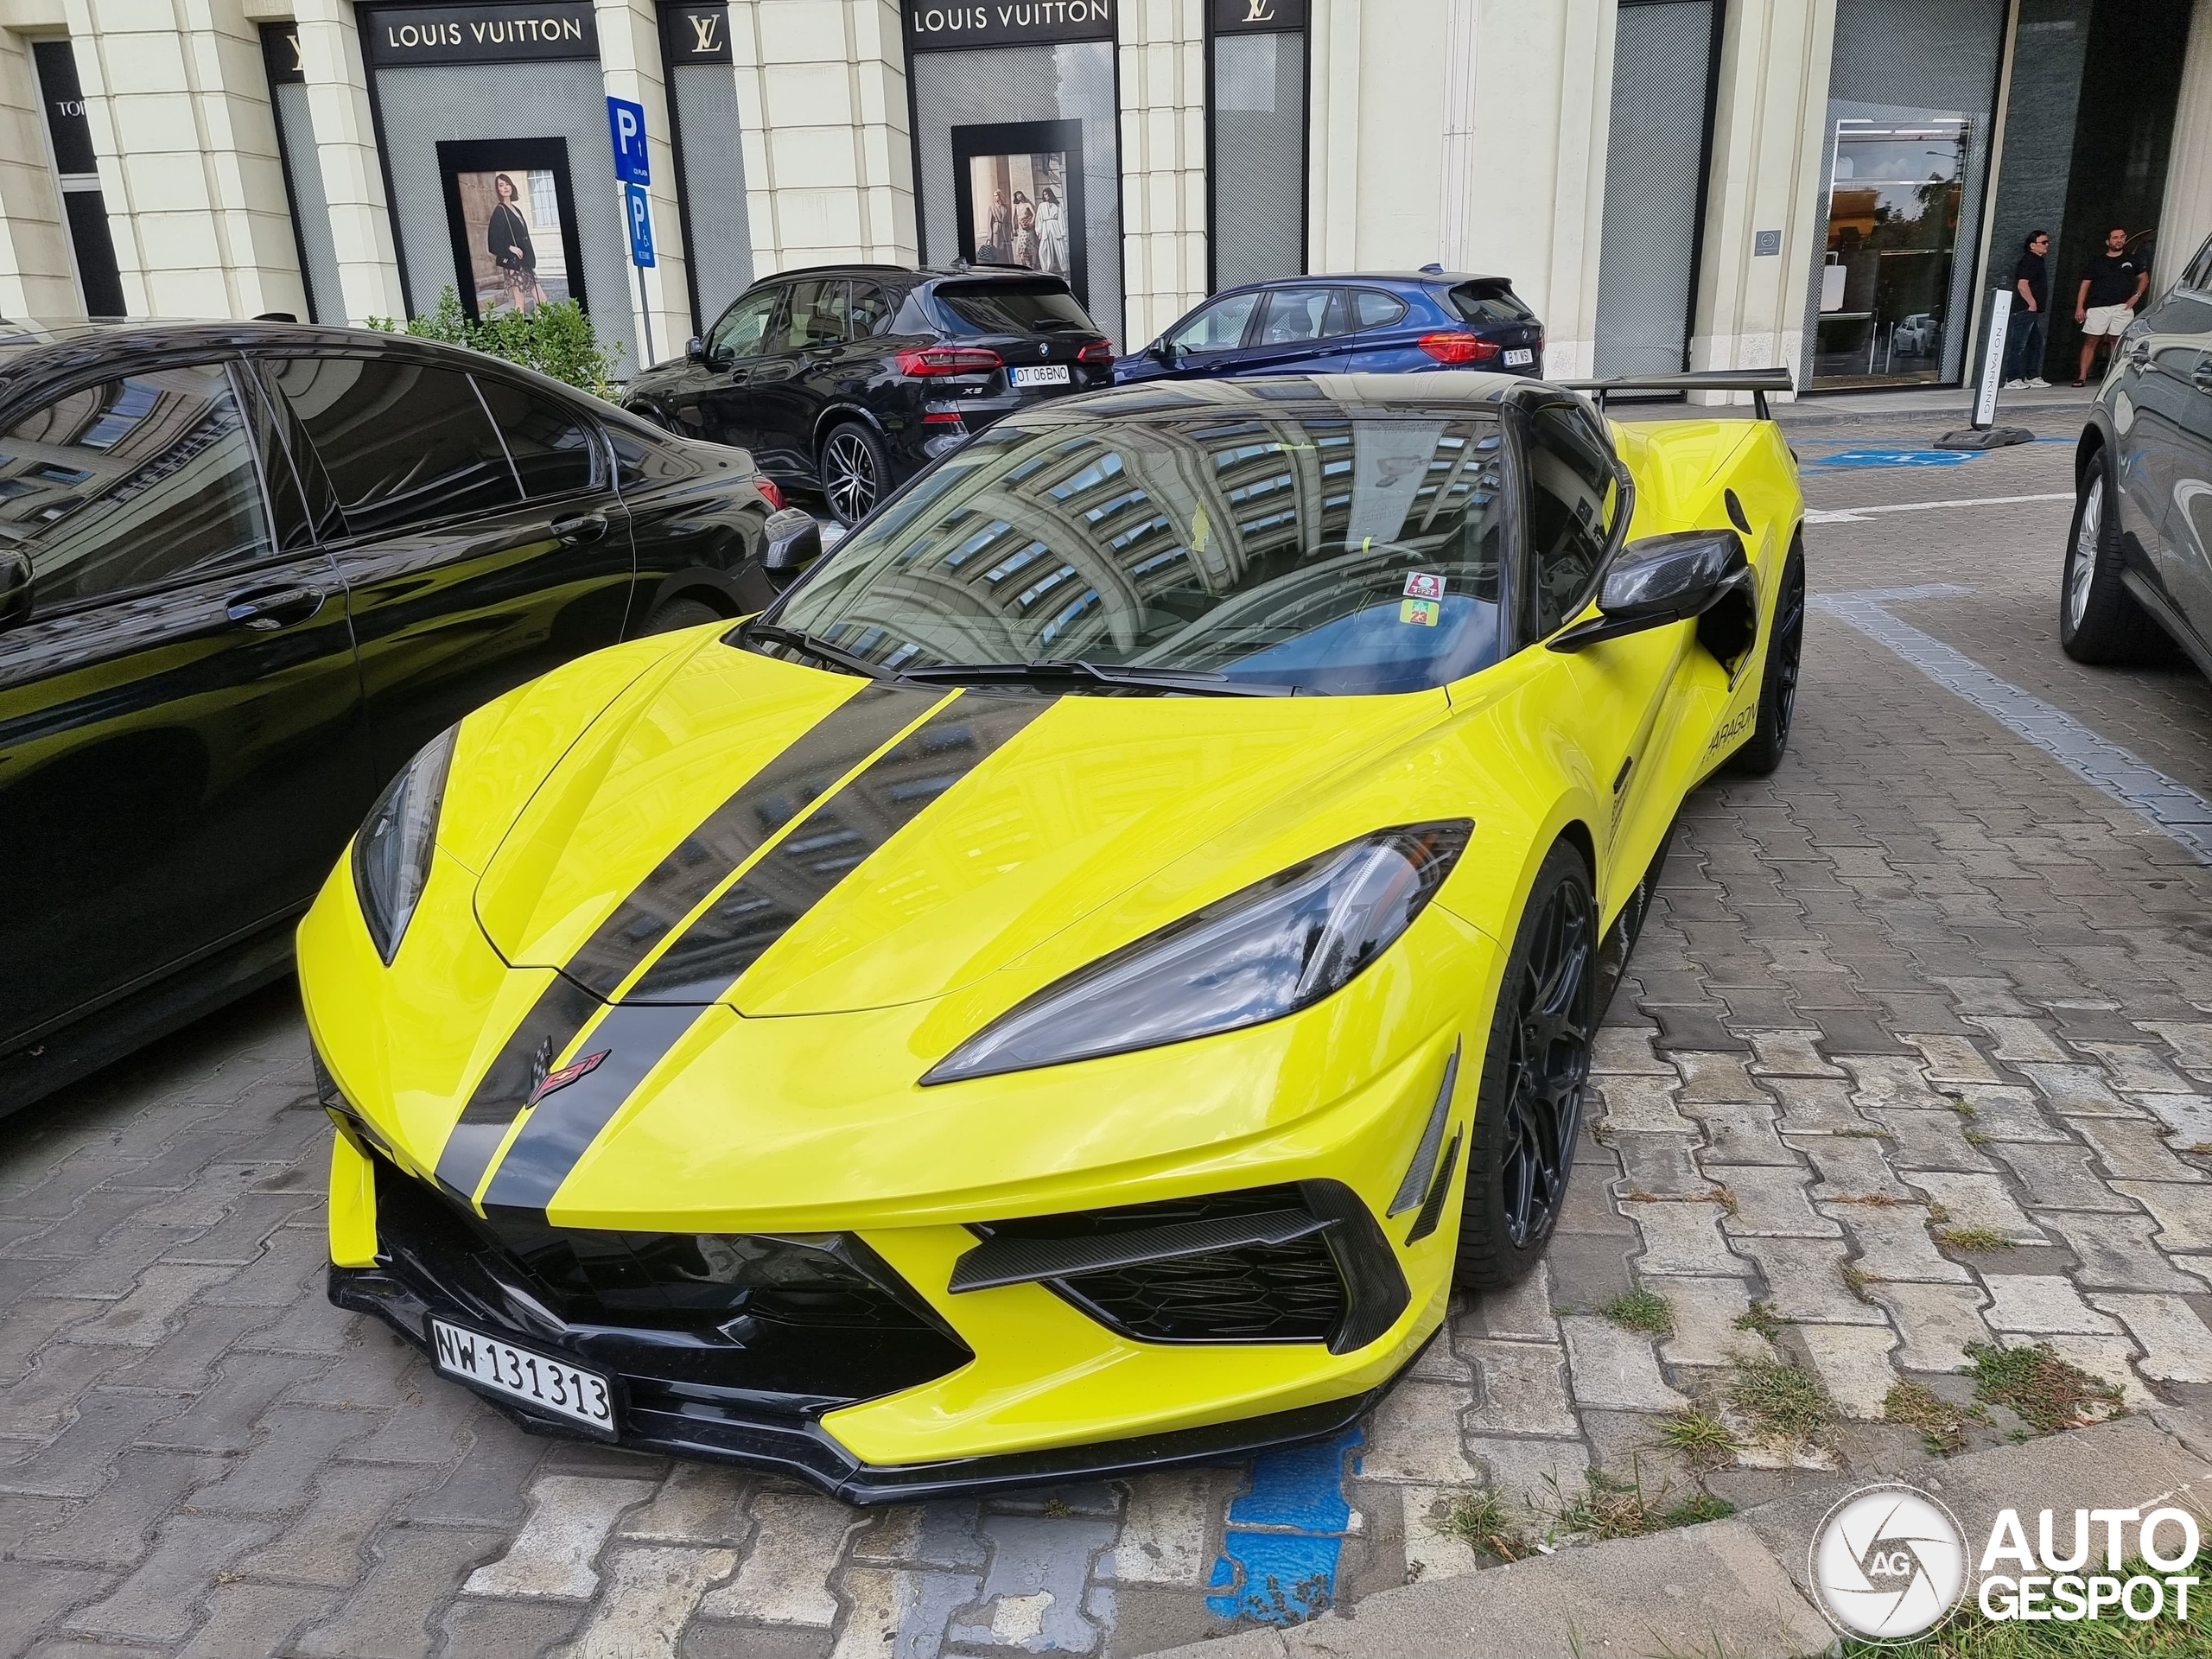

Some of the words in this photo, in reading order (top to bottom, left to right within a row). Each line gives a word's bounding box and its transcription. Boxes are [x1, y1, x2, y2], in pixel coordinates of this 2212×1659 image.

[914, 6, 988, 32] LOUIS
[997, 0, 1109, 28] VUITTON
[389, 22, 462, 48] LOUIS
[470, 17, 582, 44] VUITTON
[616, 108, 637, 154] P
[632, 195, 645, 240] P
[1994, 327, 2003, 348] NO
[1016, 369, 1030, 382] OT
[1984, 353, 1999, 414] PARKING
[1410, 611, 1428, 622] 23
[435, 1324, 477, 1374] NW
[486, 1343, 611, 1421] 131313
